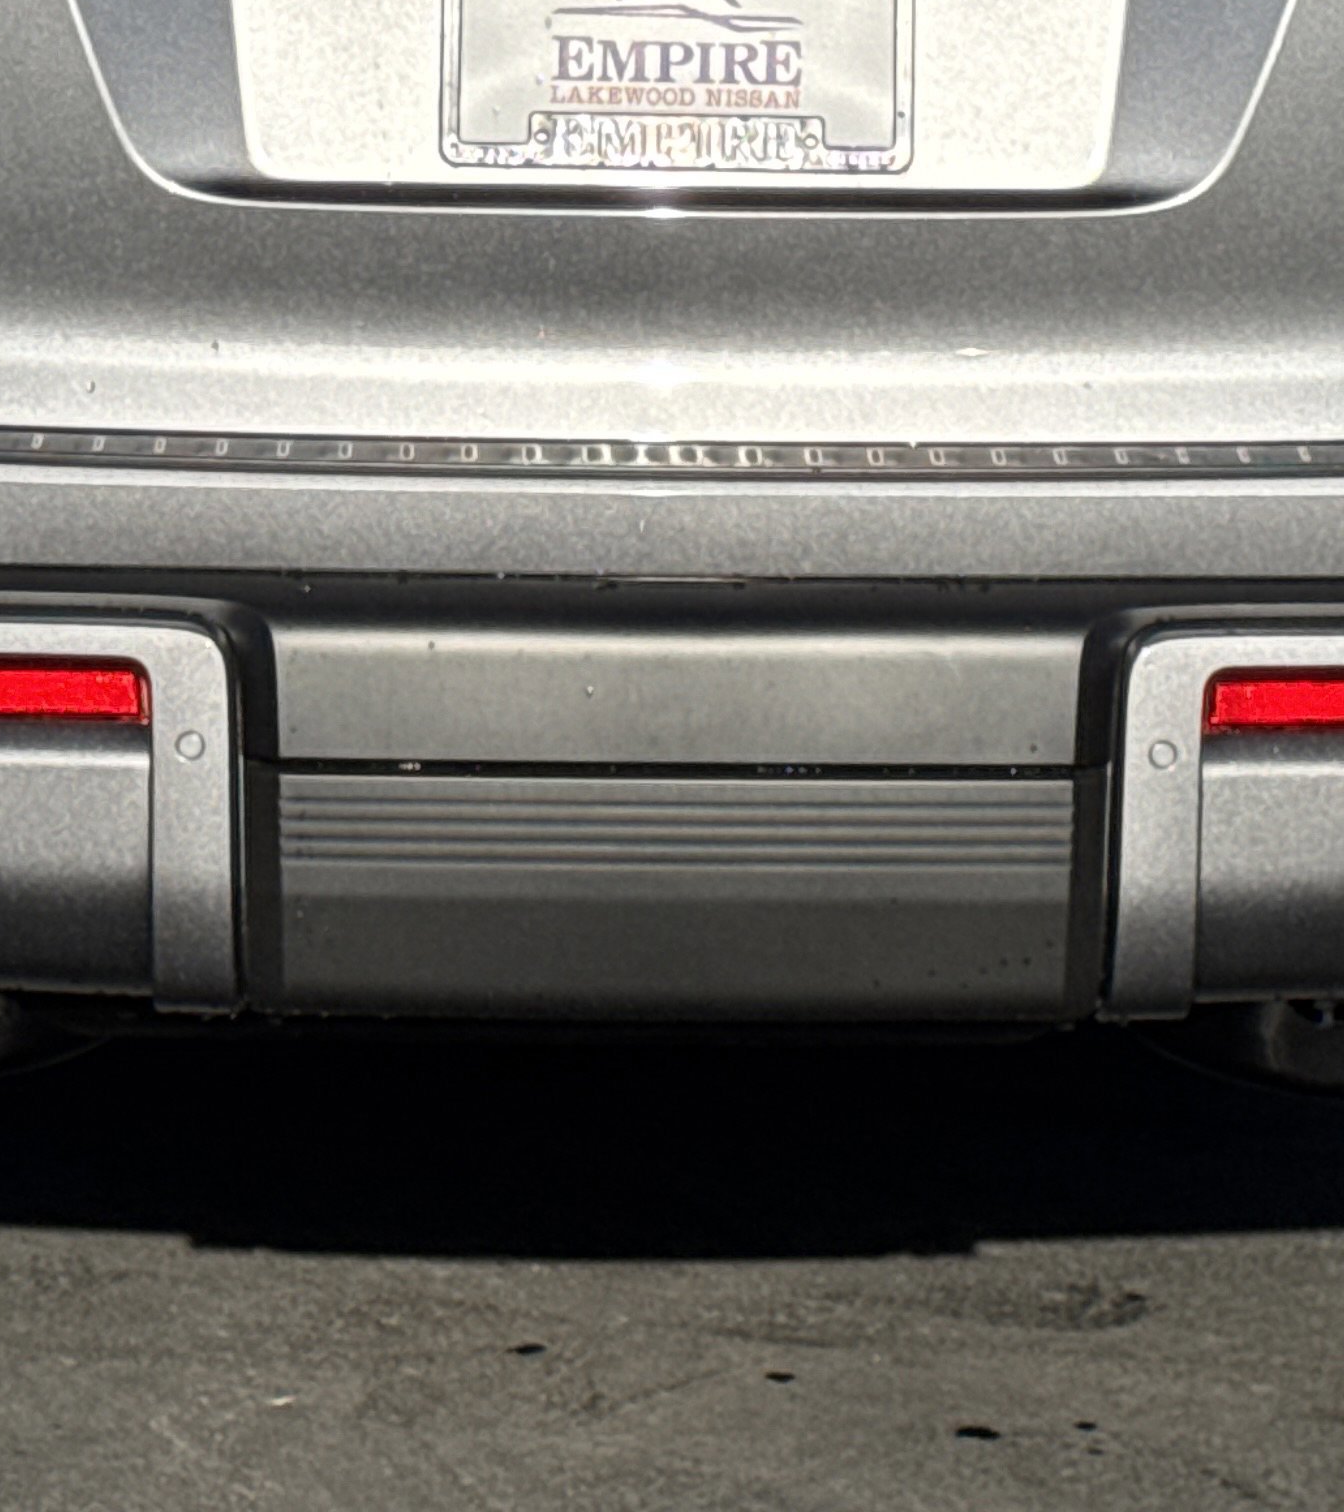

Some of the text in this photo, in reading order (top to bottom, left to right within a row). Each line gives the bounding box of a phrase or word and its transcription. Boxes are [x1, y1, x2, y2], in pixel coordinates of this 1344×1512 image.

[552, 35, 803, 88] EMPIRE
[550, 85, 801, 109] LAKEWOOD NISSAN
